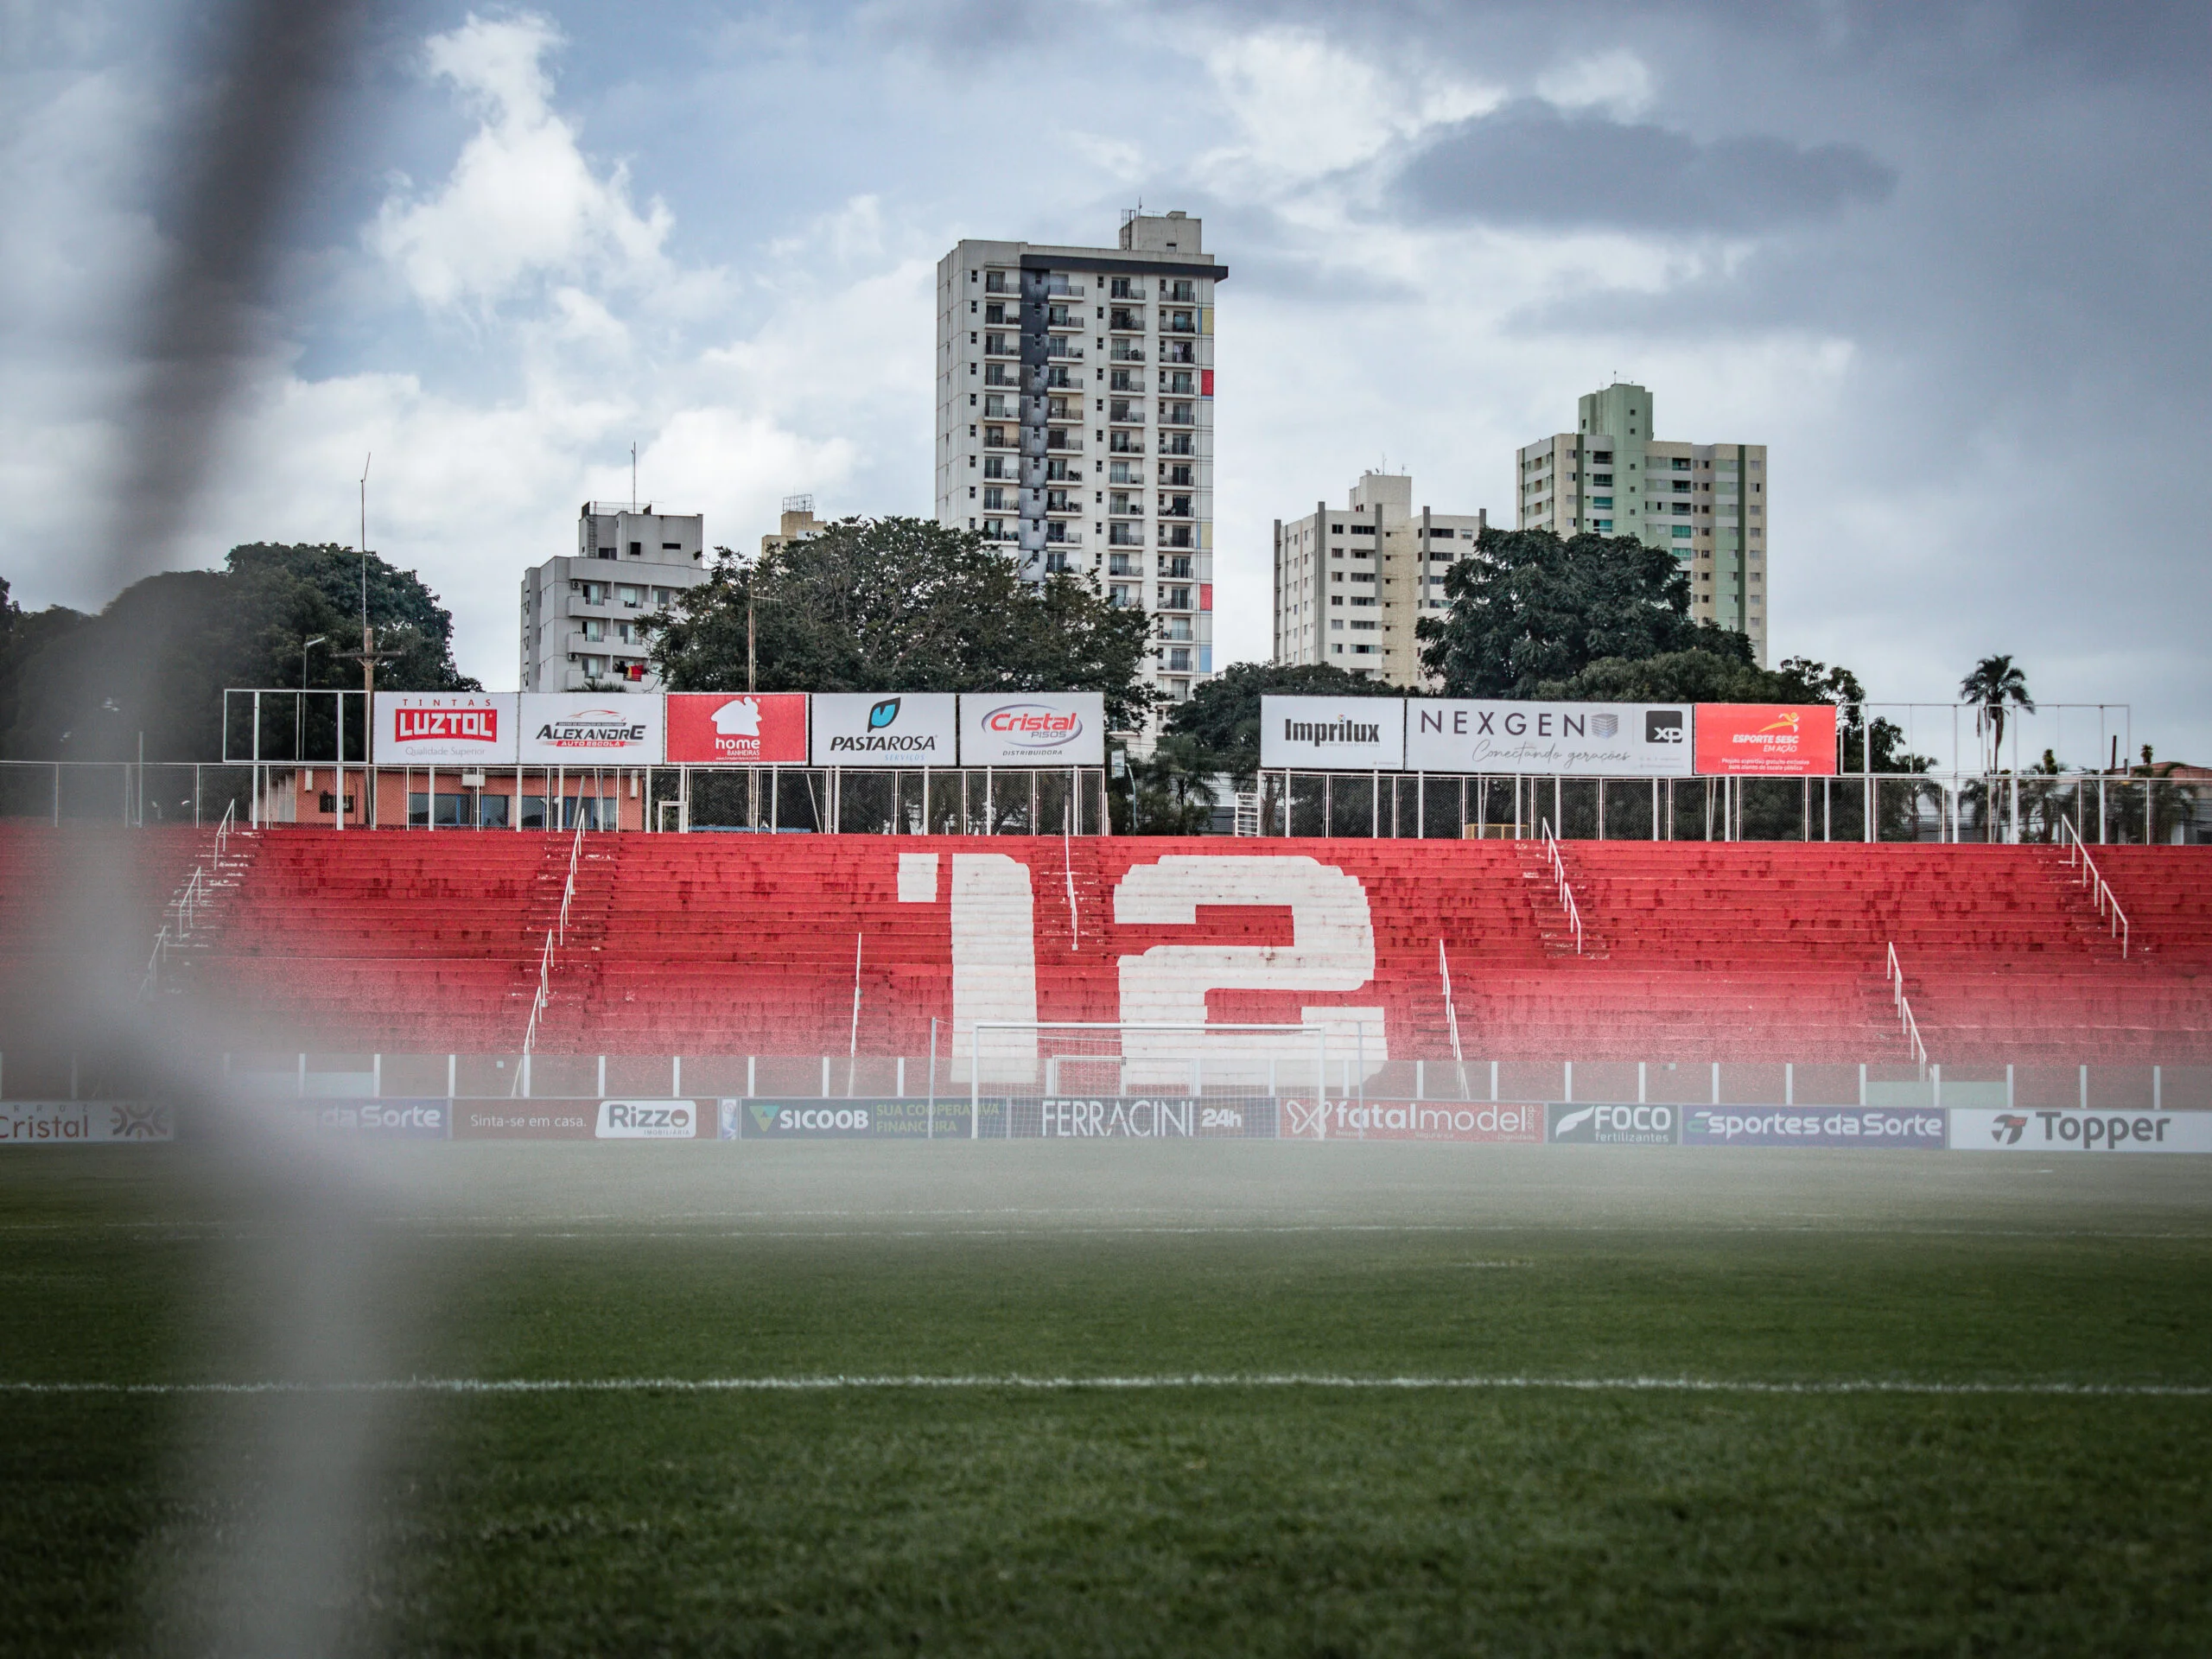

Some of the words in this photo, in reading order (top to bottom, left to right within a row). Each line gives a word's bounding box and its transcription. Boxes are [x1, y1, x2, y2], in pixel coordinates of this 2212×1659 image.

[403, 698, 491, 707] TINTAS
[399, 713, 493, 737] LUZTOL
[990, 712, 1077, 732] Cristal
[1421, 709, 1585, 737] NEXGEN
[536, 724, 646, 741] ALEXANDRE
[1285, 718, 1380, 747] Imprilux
[1732, 734, 1775, 744] ESPORTE
[1776, 734, 1800, 744] SESC
[405, 747, 448, 756] Qualidade
[451, 747, 486, 757] Superior
[715, 738, 760, 749] home
[830, 735, 936, 751] PASTAROSA
[1472, 739, 1562, 765] Conectando
[1777, 744, 1798, 753] AÇÃO
[608, 1104, 690, 1128] Rizzo
[779, 1109, 869, 1130] SICOOB
[876, 1104, 902, 1116] SUA
[907, 1103, 1000, 1116] COOPERAIVA
[1042, 1100, 1194, 1137] FERRACINI
[1201, 1108, 1242, 1128] 24h
[1337, 1101, 1526, 1131] fatalmodel
[1594, 1105, 1671, 1131] FOCO
[471, 1115, 524, 1128] Sinta-se
[529, 1119, 550, 1128] em
[554, 1117, 587, 1128] casa.
[876, 1121, 957, 1133] FINANCIRA
[2036, 1111, 2171, 1149] Topper
[1595, 1131, 1669, 1142] fertilizantes
